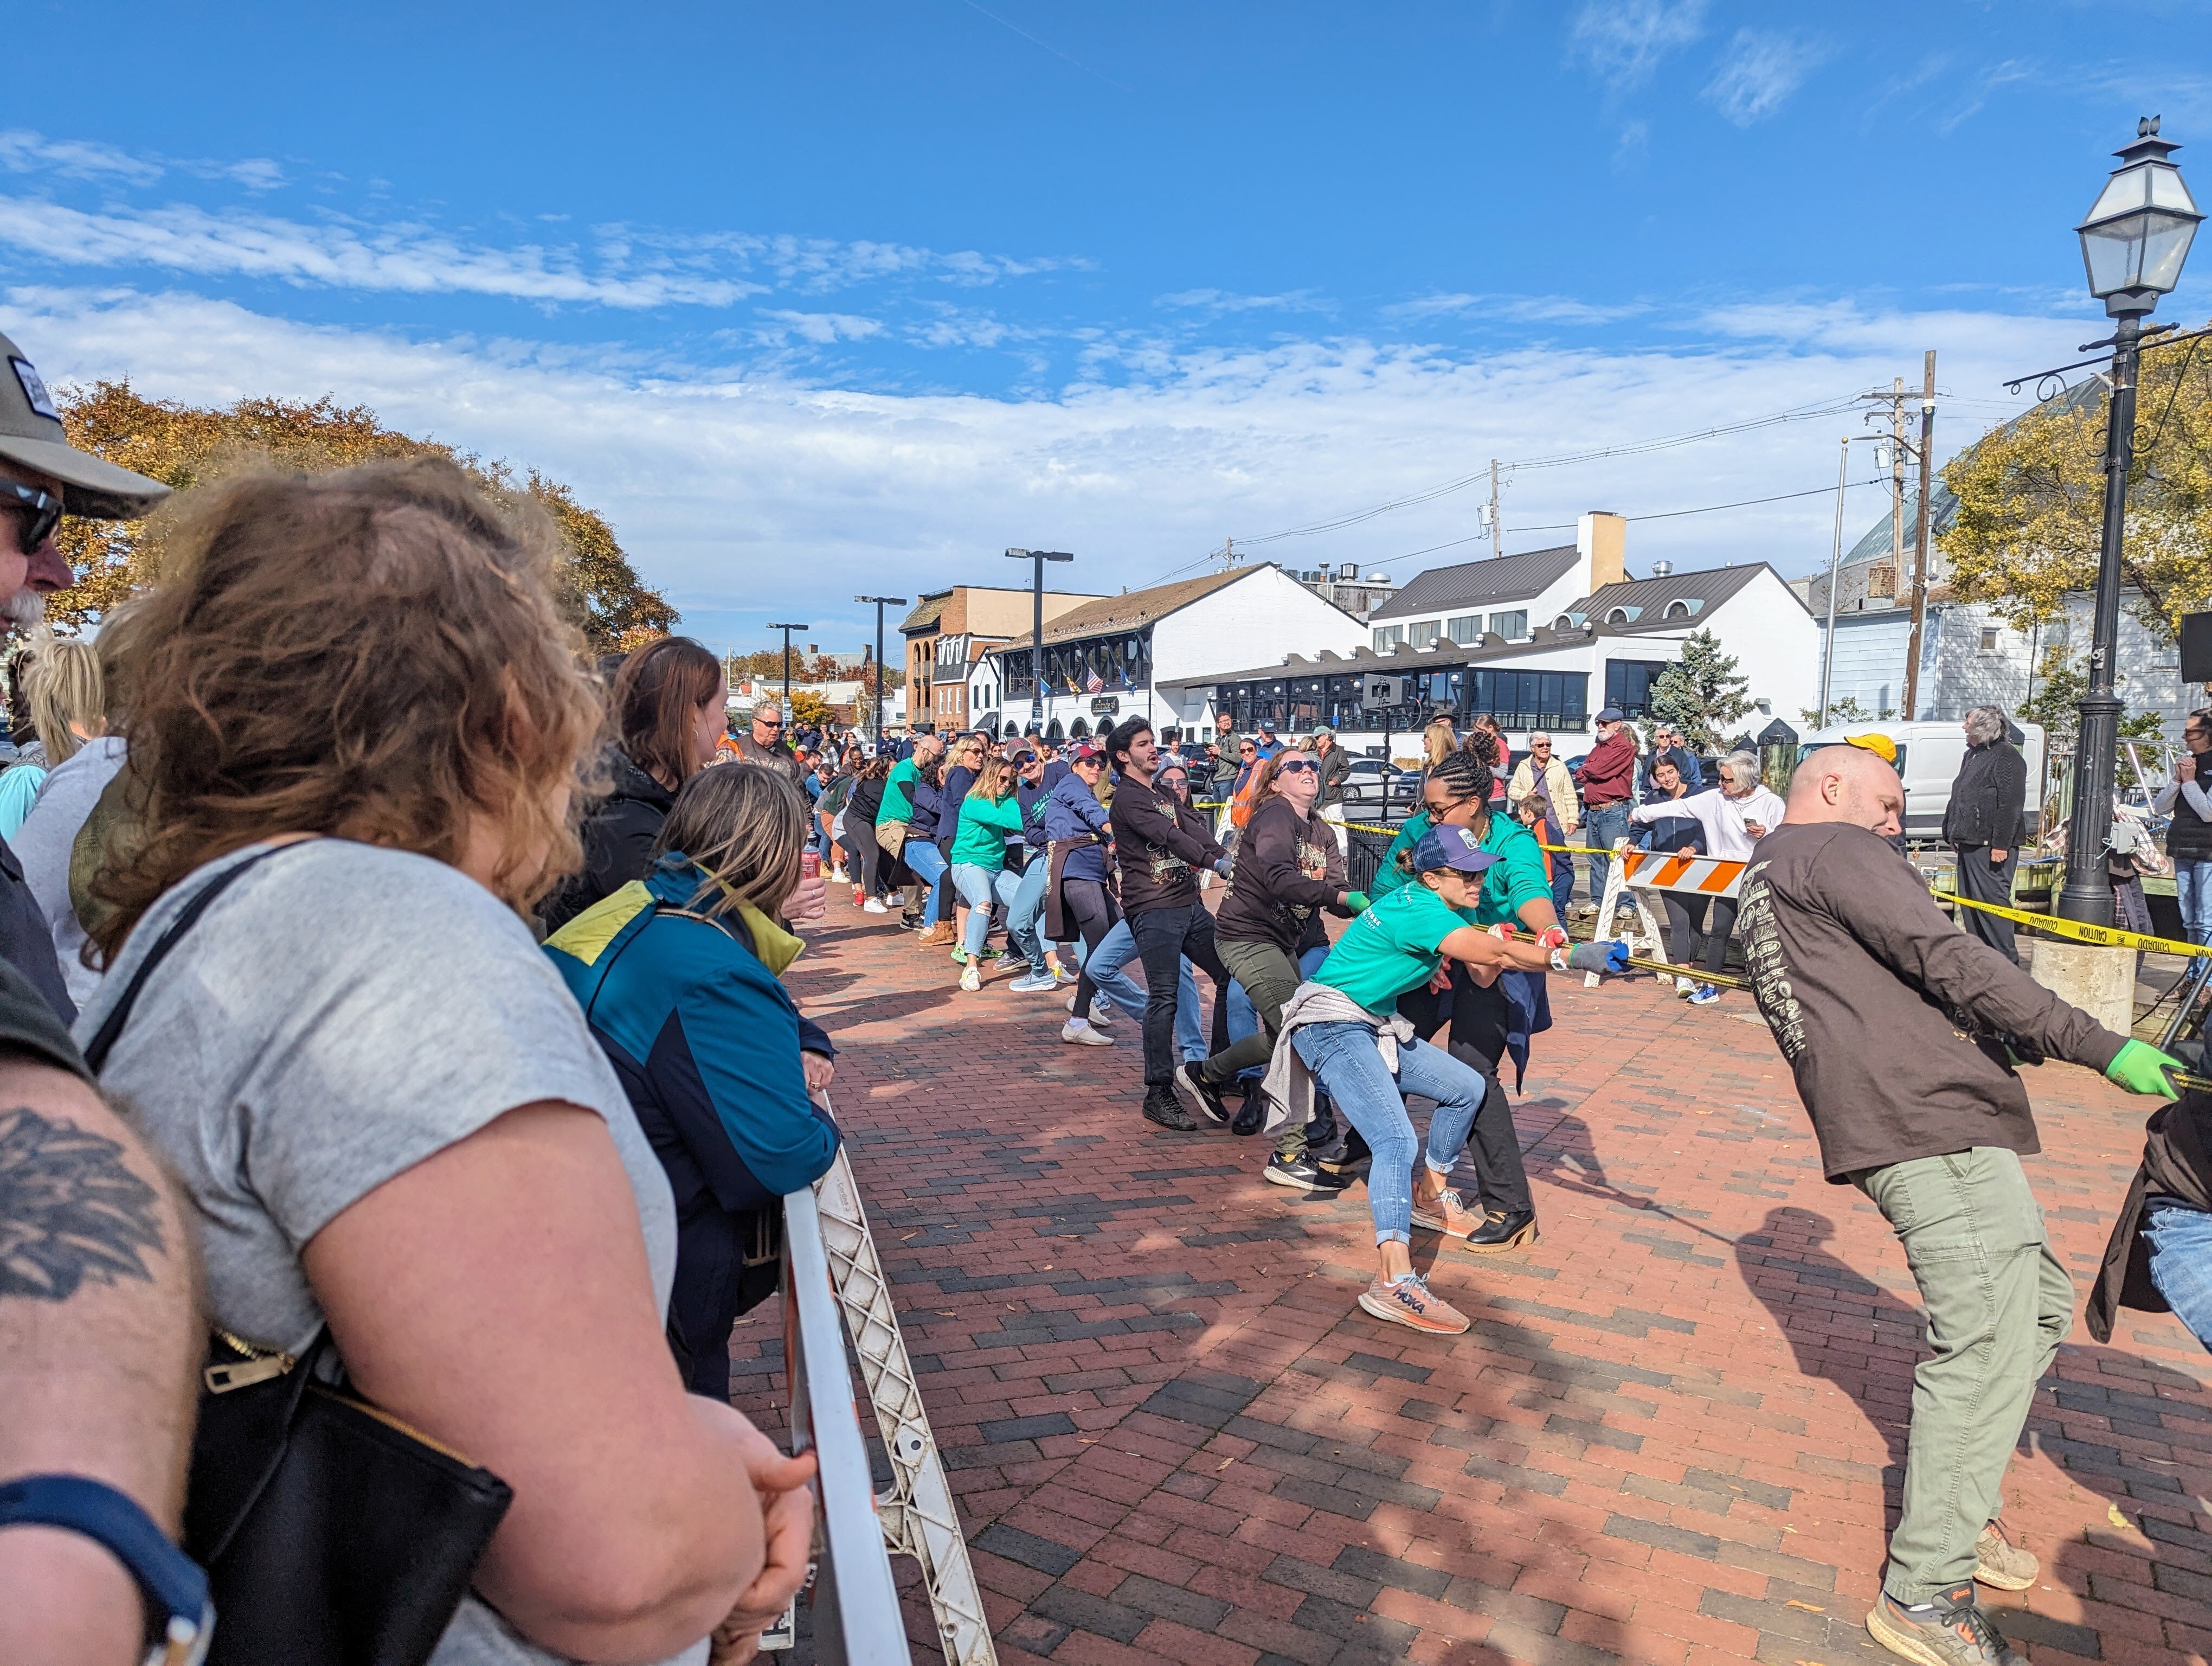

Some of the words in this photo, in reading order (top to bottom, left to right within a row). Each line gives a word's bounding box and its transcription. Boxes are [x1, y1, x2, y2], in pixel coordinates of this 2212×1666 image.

[2029, 916, 2058, 931] CUIDADO
[2078, 926, 2107, 943] CAUTION
[2138, 938, 2170, 953] CUIDADO
[1392, 1289, 1425, 1314] HOKA
